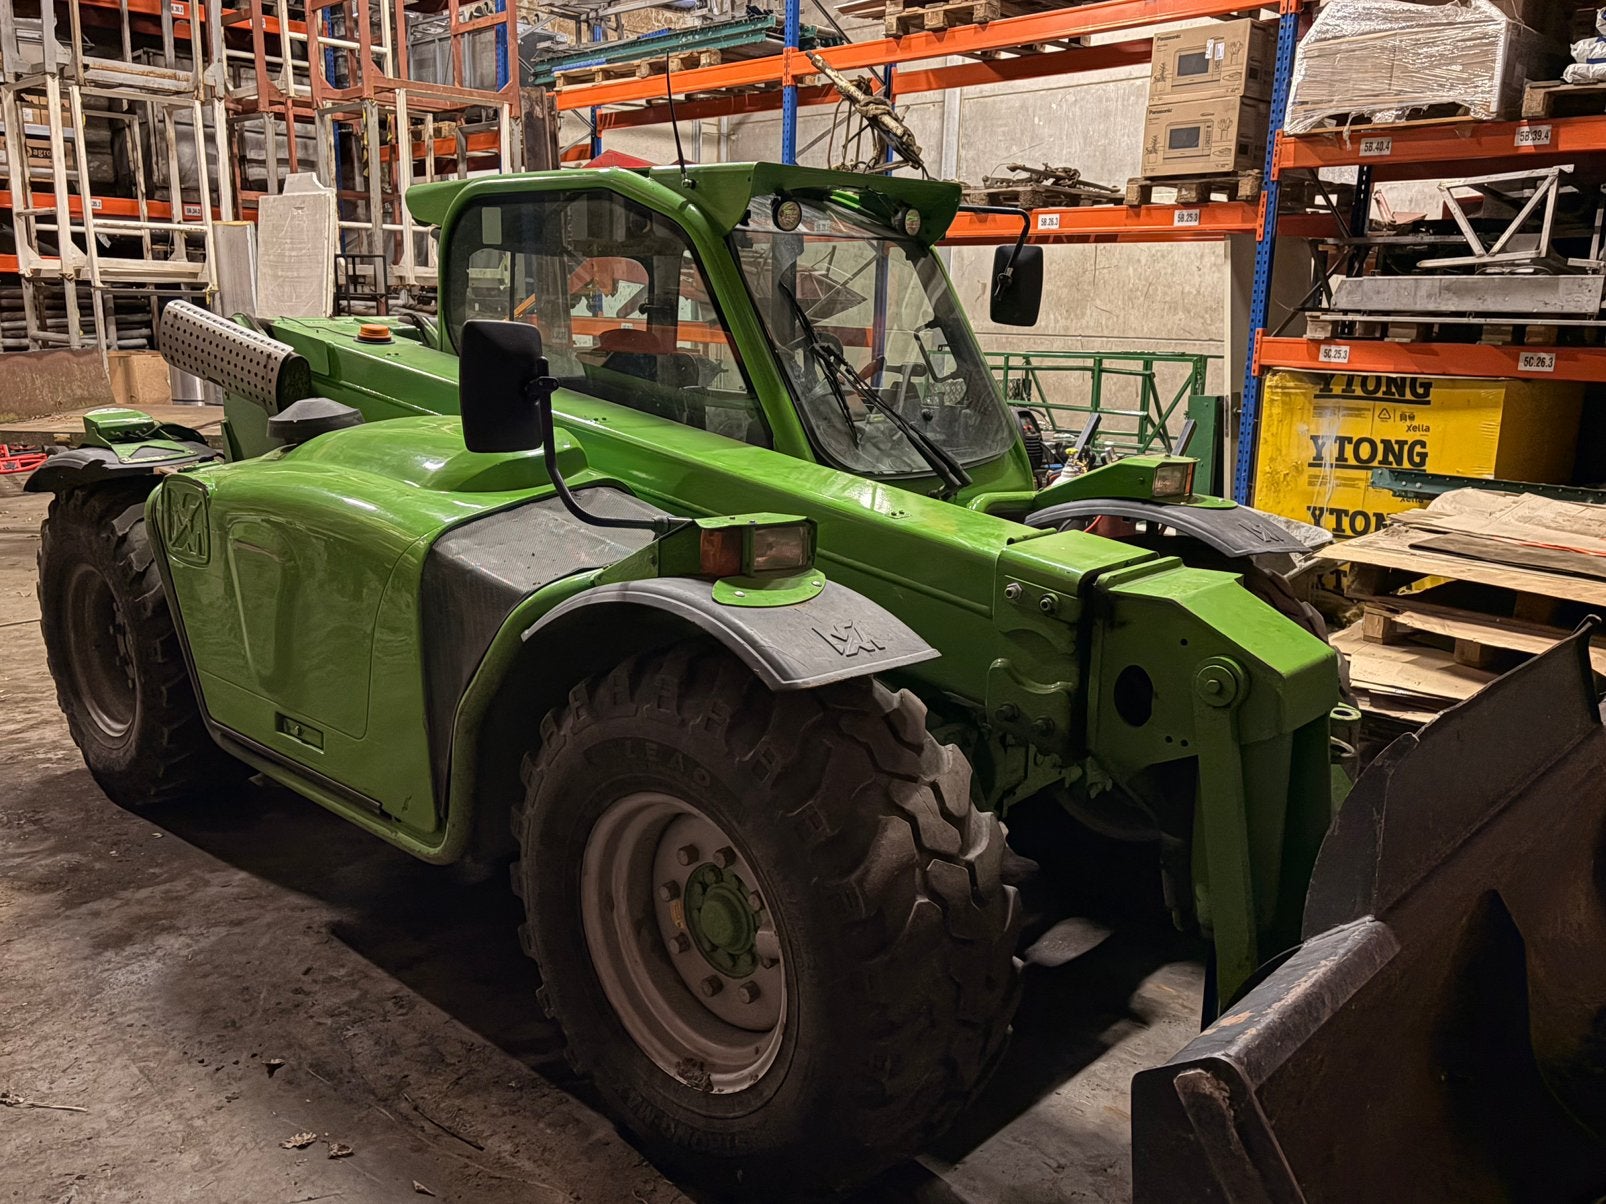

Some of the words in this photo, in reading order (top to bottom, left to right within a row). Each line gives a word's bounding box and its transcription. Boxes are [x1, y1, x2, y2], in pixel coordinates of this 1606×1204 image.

[1519, 129, 1550, 143] 5B.39.4
[1364, 140, 1390, 153] 5B.40.4
[1040, 217, 1059, 227] 5B.26.3
[1177, 212, 1198, 223] 5B.25.3
[1323, 348, 1348, 361] 5C.25.3
[1523, 355, 1554, 369] 5C.26.3
[1318, 374, 1433, 399] YTONG
[1310, 435, 1429, 468] YTONG
